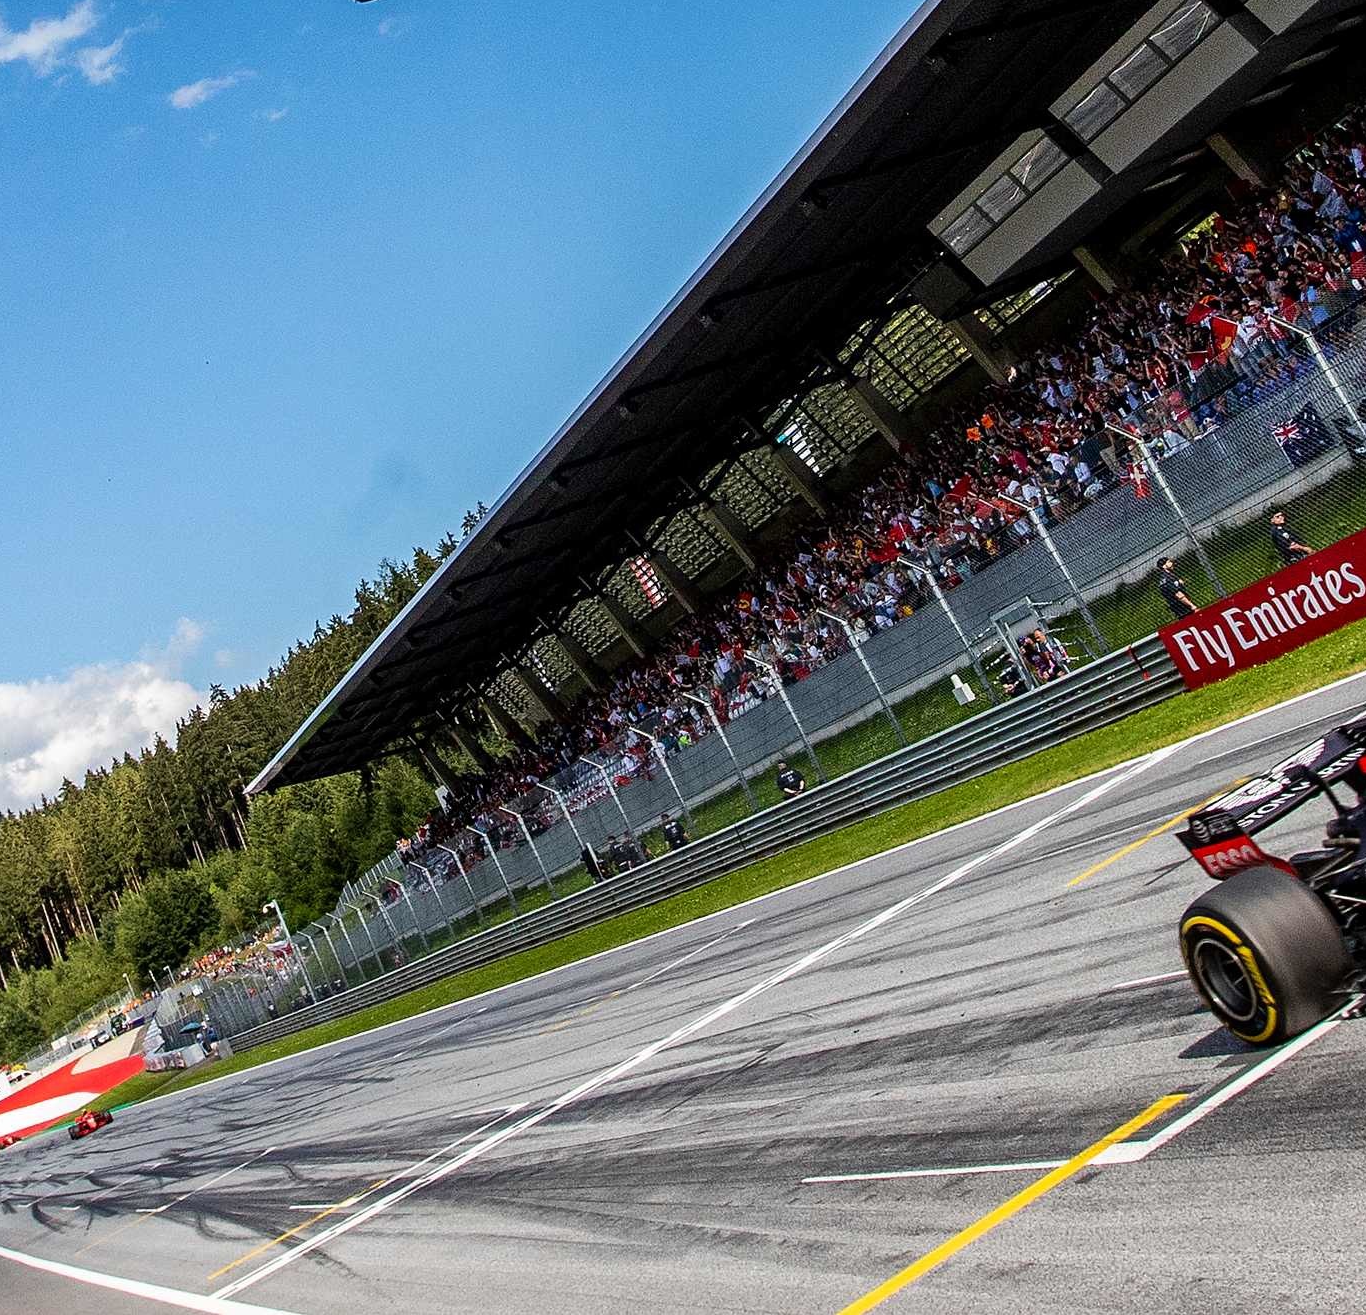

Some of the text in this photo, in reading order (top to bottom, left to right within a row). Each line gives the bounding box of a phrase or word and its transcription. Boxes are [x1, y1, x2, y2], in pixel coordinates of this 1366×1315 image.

[1173, 563, 1366, 671] Fly Emirates
[1238, 790, 1296, 829] STON
